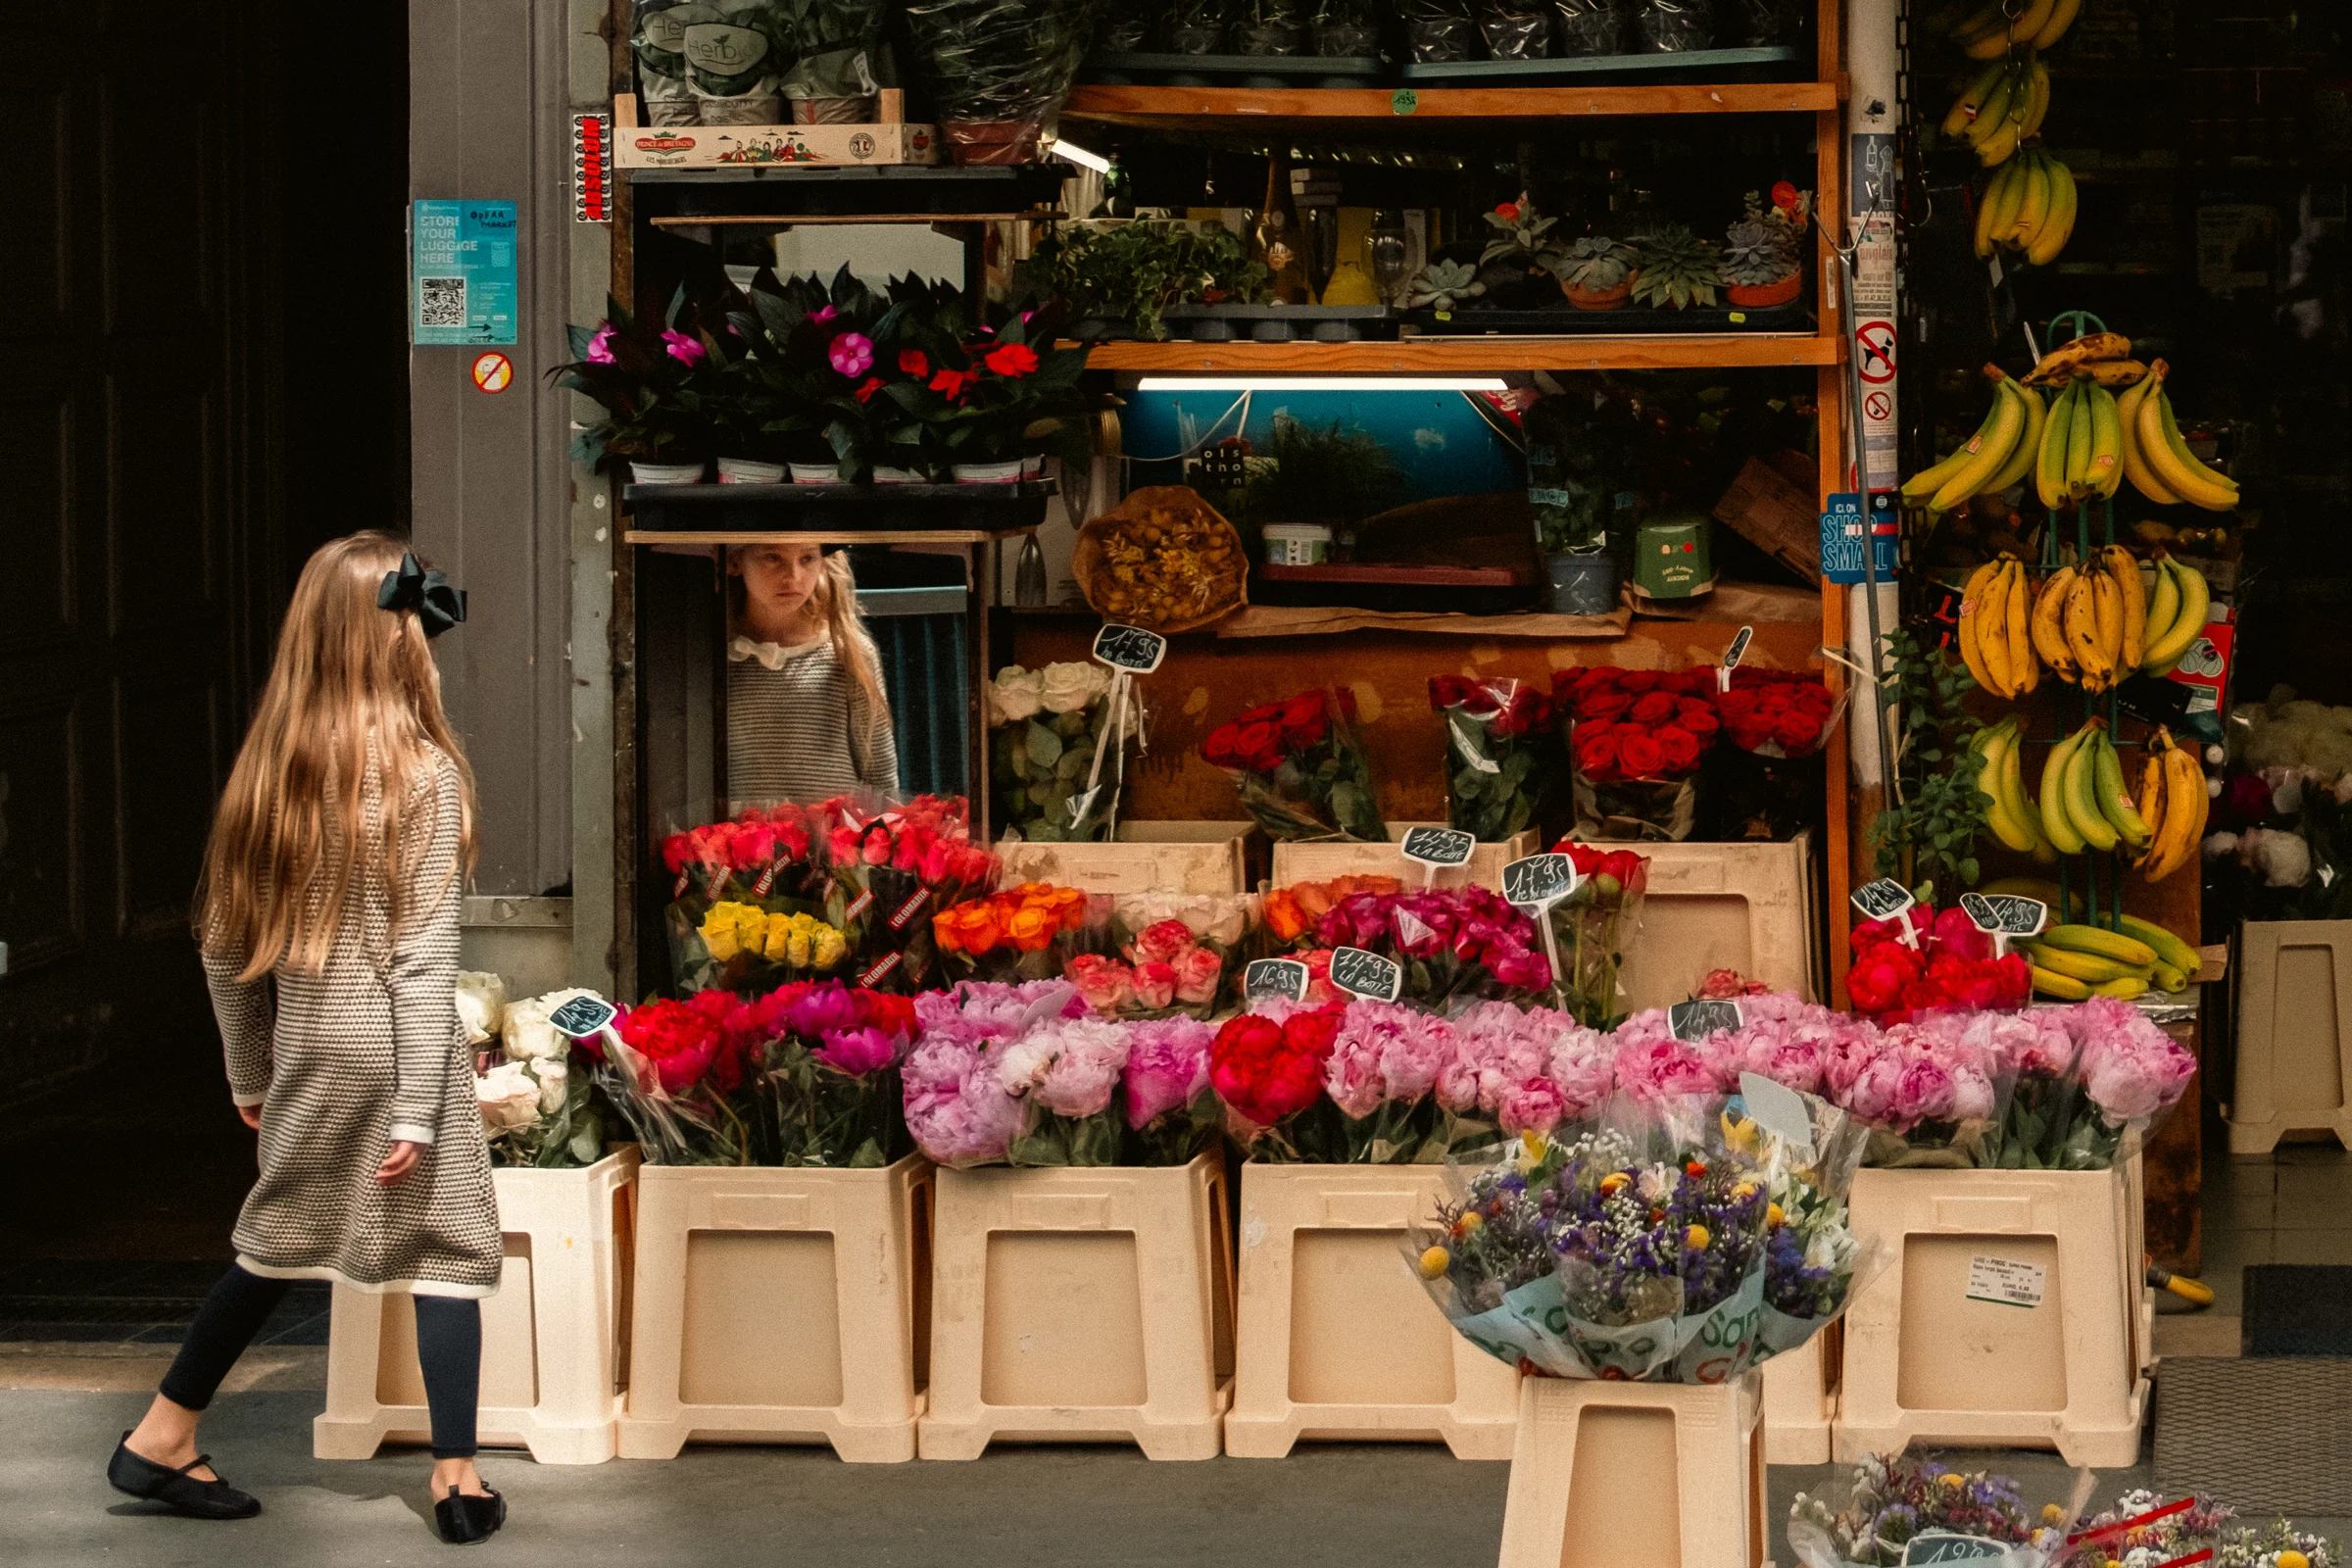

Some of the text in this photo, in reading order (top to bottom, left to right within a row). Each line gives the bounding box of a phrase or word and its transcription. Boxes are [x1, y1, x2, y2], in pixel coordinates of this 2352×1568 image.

[420, 228, 456, 239] YOUR
[420, 253, 454, 263] HERE
[1823, 543, 1887, 571] SMAL
